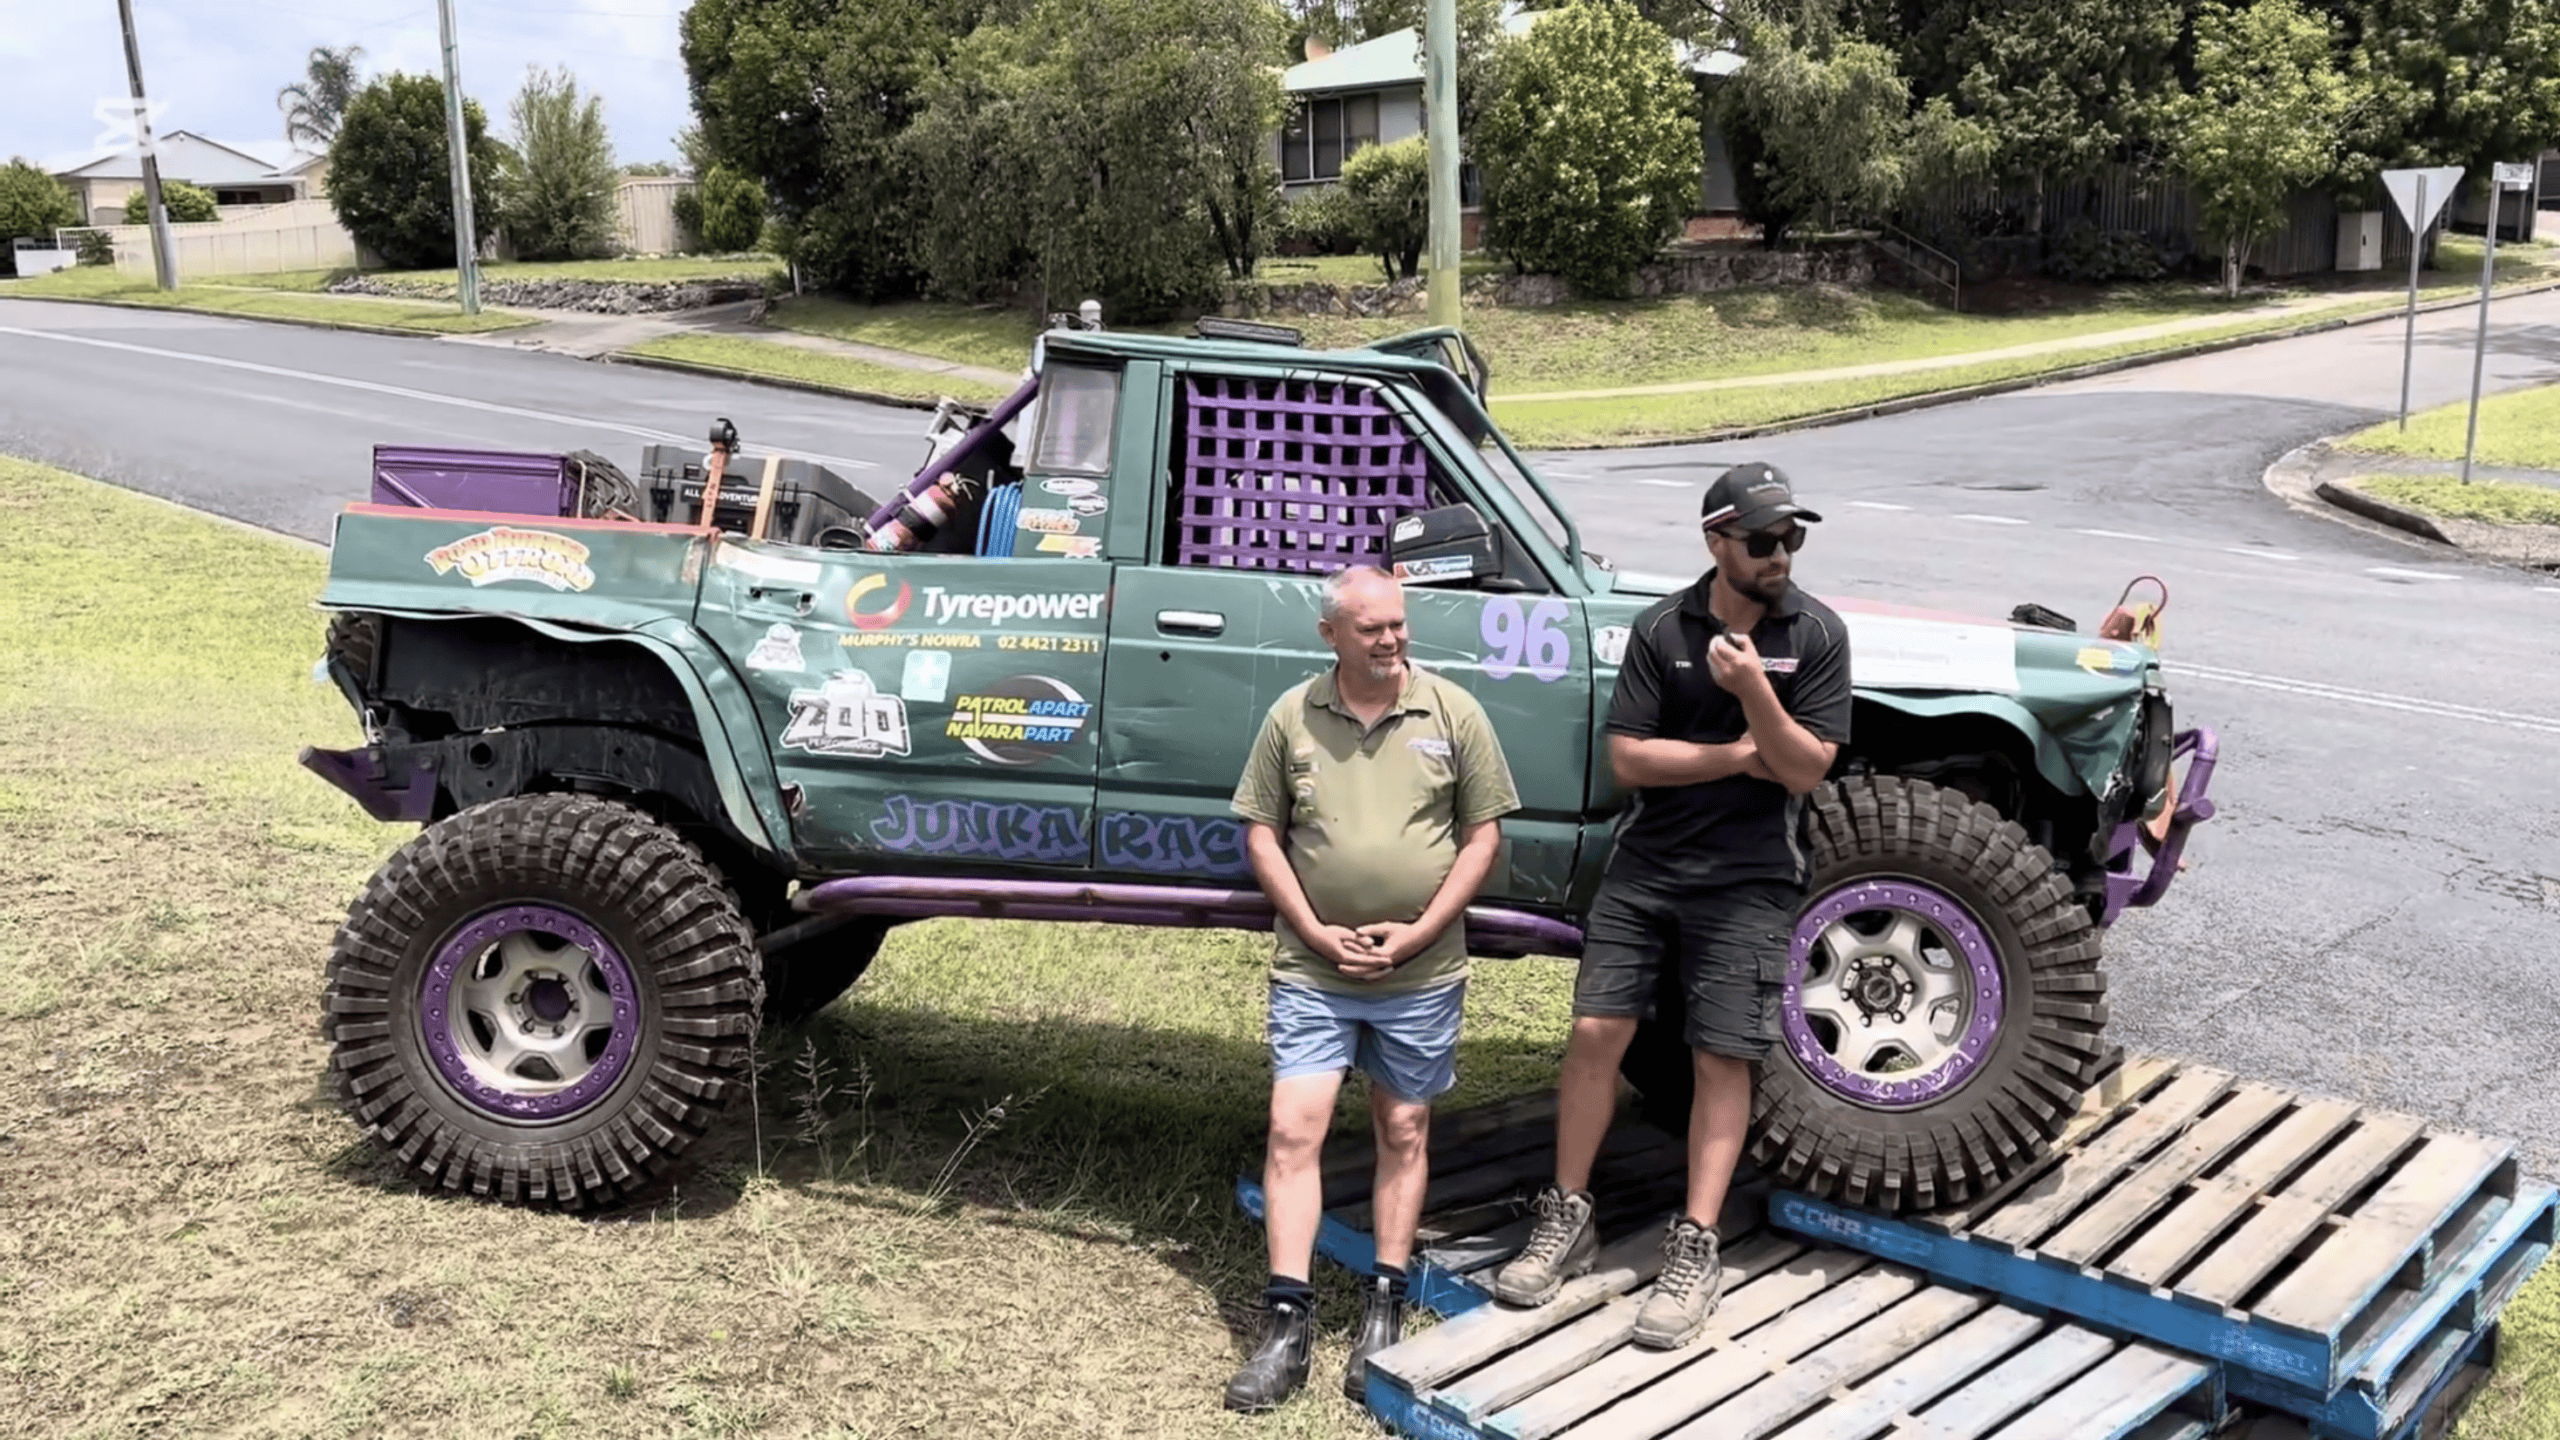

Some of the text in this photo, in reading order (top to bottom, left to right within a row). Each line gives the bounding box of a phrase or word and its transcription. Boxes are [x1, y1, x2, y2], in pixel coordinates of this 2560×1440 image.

[684, 488, 700, 497] ALL
[921, 586, 1106, 626] Tyrepower
[838, 633, 1100, 653] MURPHY'S NOWRA 02 4421 2311
[1480, 595, 1570, 682] 96
[869, 793, 1092, 859] JUNKA
